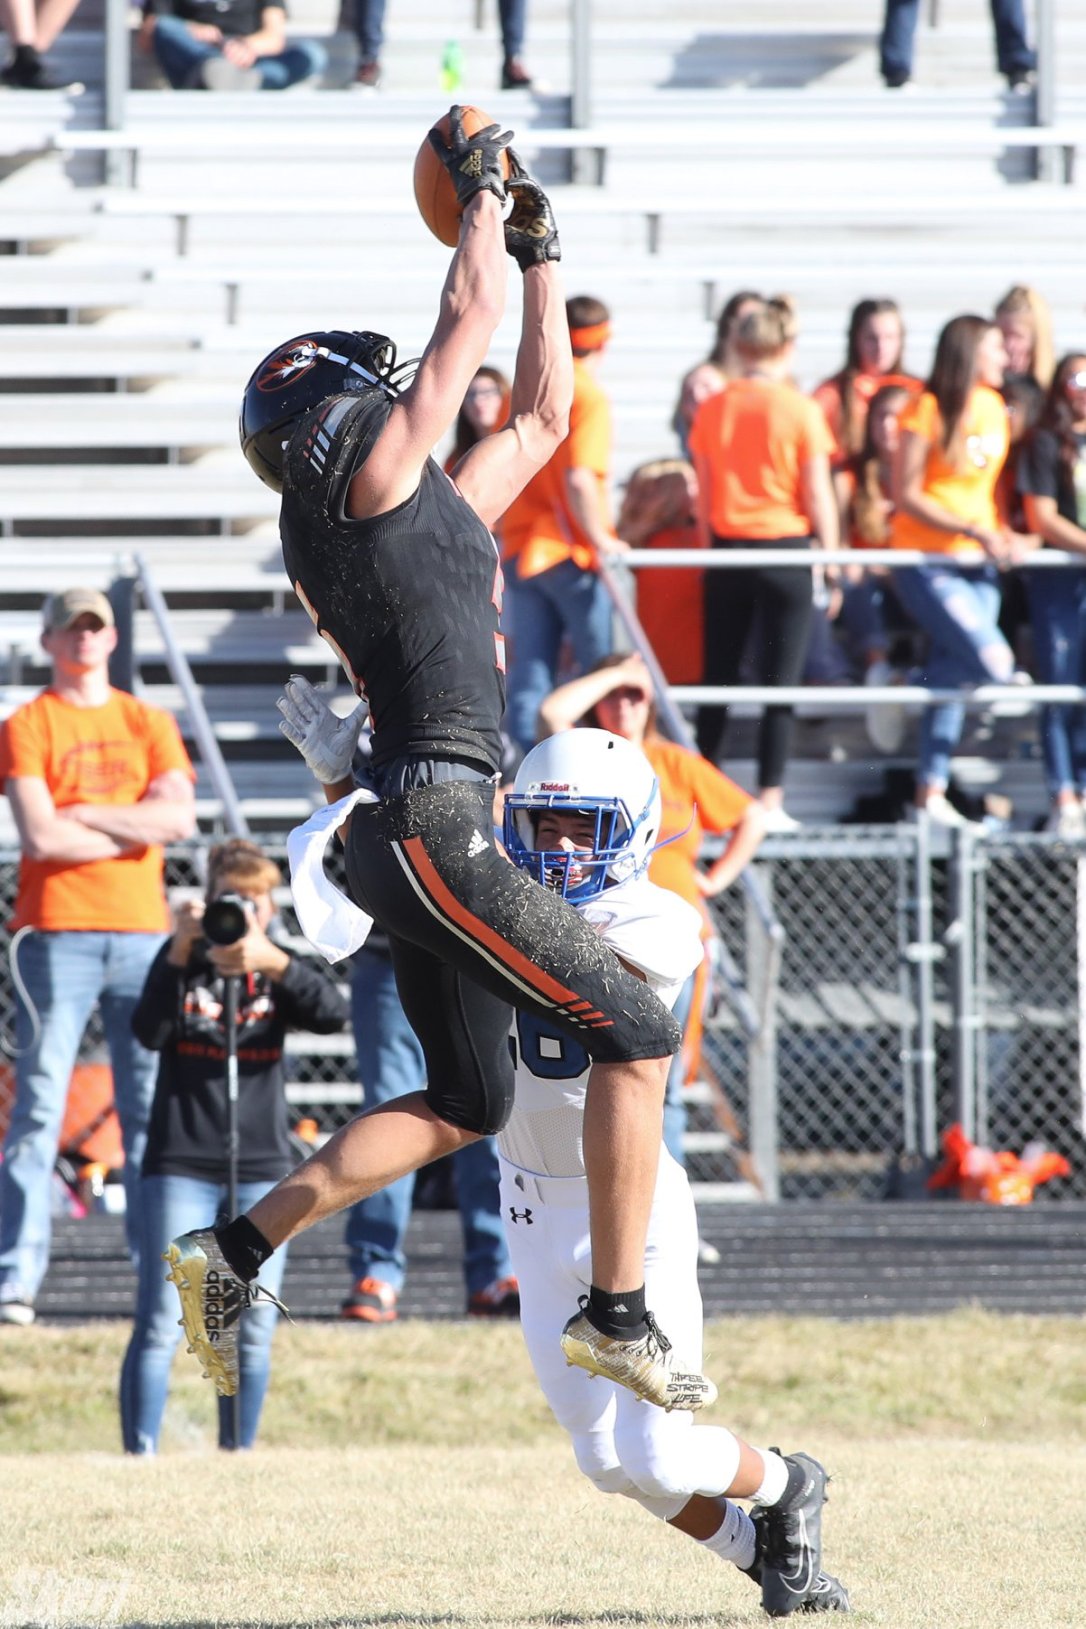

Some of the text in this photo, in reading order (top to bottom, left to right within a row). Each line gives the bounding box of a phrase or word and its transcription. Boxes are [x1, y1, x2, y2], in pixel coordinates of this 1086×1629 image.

[205, 1270, 224, 1342] adidas
[670, 1371, 705, 1383] THREE
[666, 1383, 709, 1392] STRIPE
[672, 1393, 702, 1403] LIFE
